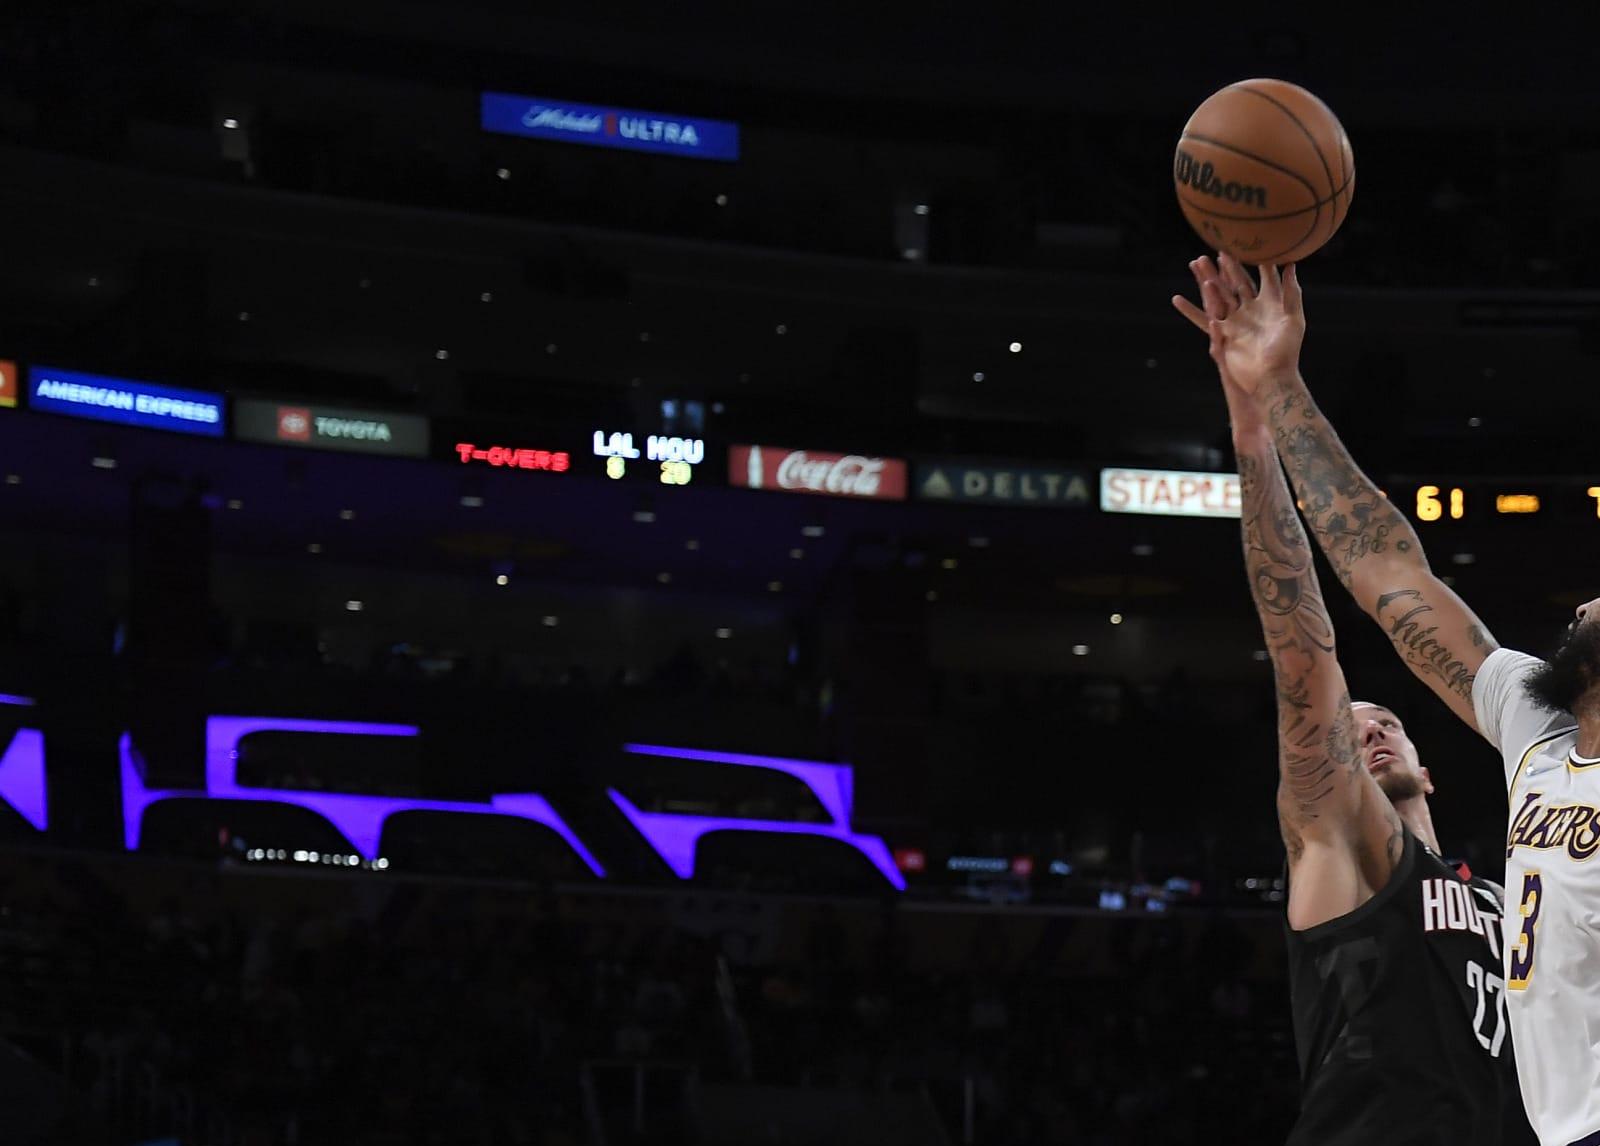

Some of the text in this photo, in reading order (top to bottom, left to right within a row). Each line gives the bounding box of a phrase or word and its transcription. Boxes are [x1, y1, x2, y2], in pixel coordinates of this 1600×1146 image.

[619, 116, 699, 146] ULTRA
[1176, 150, 1267, 209] Wilson
[36, 378, 219, 424] AMERICAN EXPRESS
[314, 415, 392, 443] TOYOTA
[455, 442, 571, 473] T-OVERS
[593, 430, 704, 464] LAL HOU
[963, 473, 1090, 500] DELTA
[1507, 867, 1545, 992] 3
[1466, 959, 1507, 1058] 27
